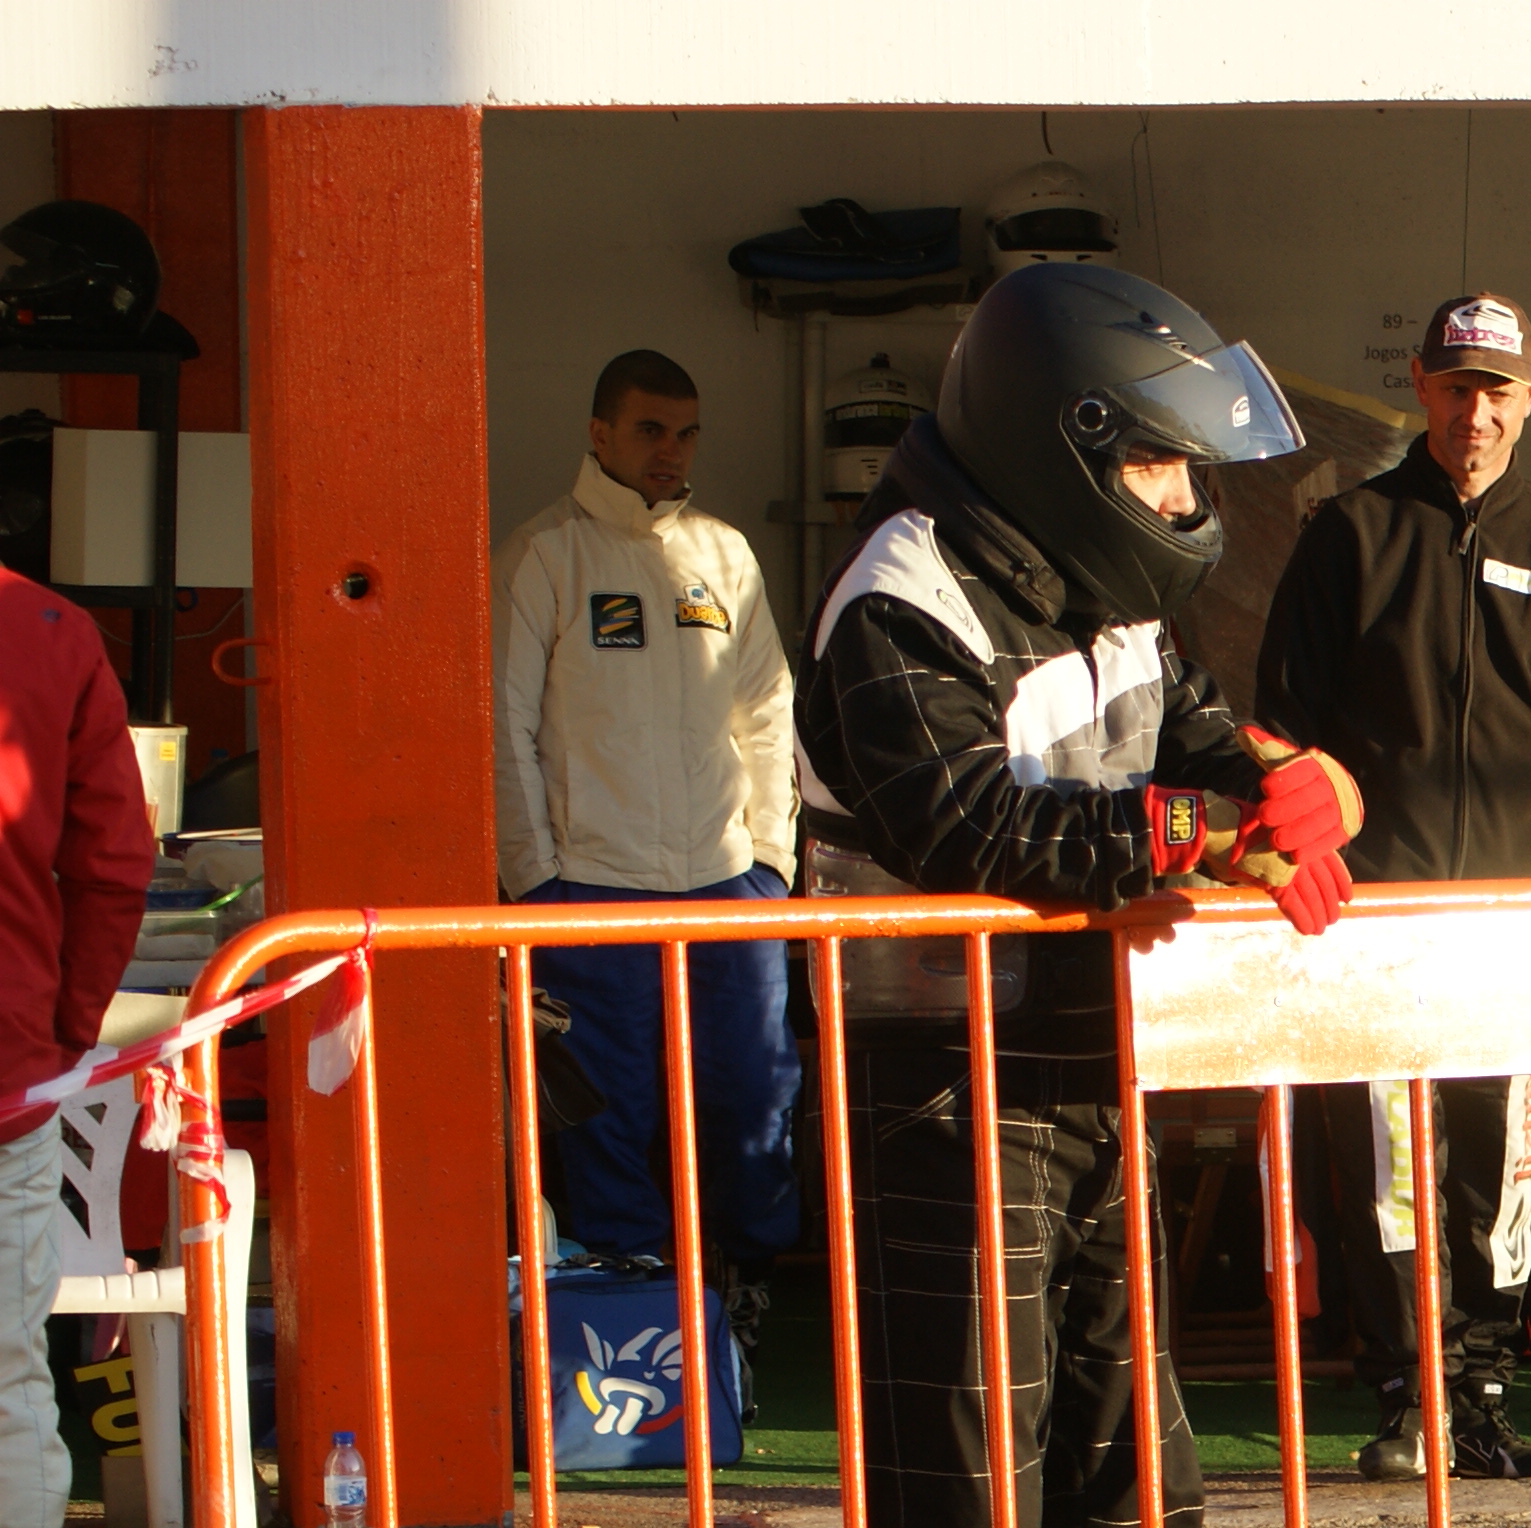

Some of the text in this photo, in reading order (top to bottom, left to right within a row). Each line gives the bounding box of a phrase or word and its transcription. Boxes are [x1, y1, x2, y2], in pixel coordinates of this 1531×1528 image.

[1383, 314, 1403, 330] 89
[1364, 345, 1408, 363] Jogos
[597, 635, 641, 646] SENNA
[1172, 797, 1191, 840] OMP
[1386, 1080, 1414, 1237] LADUR
